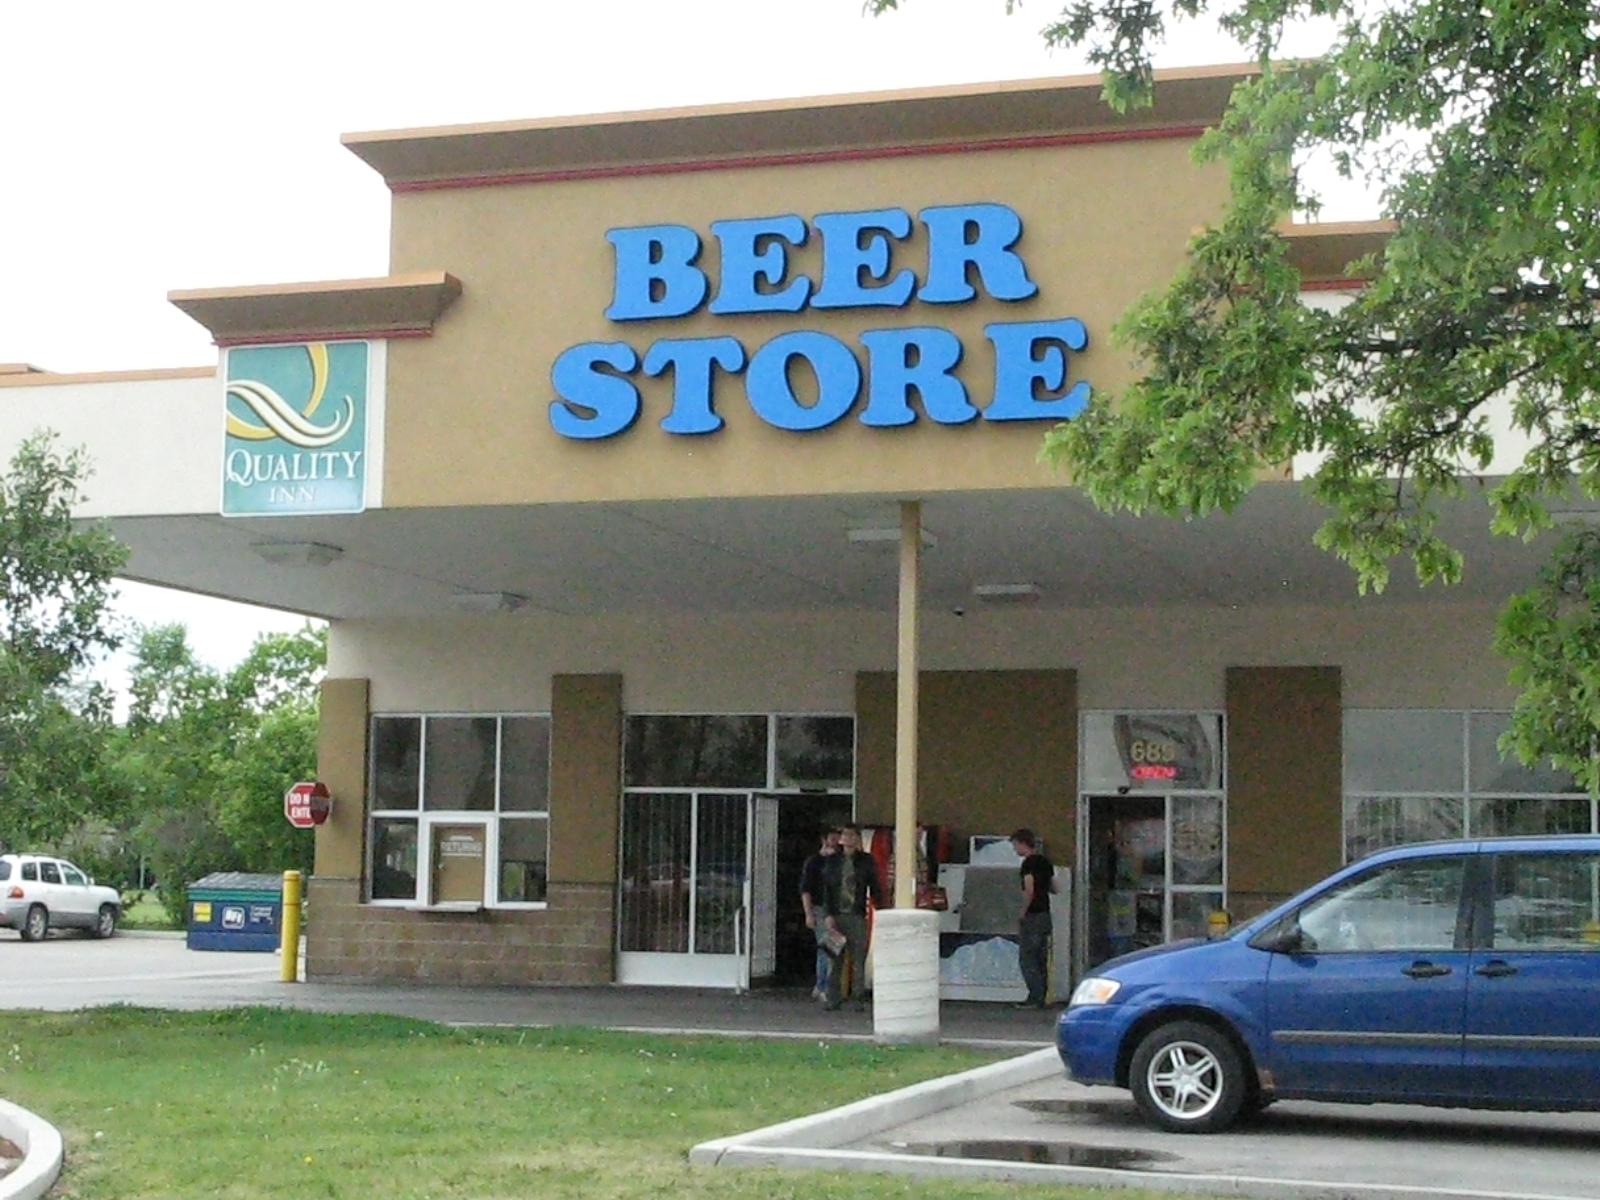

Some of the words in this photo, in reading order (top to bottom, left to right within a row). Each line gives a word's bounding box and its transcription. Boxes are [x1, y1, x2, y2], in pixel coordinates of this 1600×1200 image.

[604, 202, 1038, 323] BEER
[549, 317, 1092, 439] STORE
[226, 448, 362, 487] QUALITY
[269, 485, 316, 503] INN
